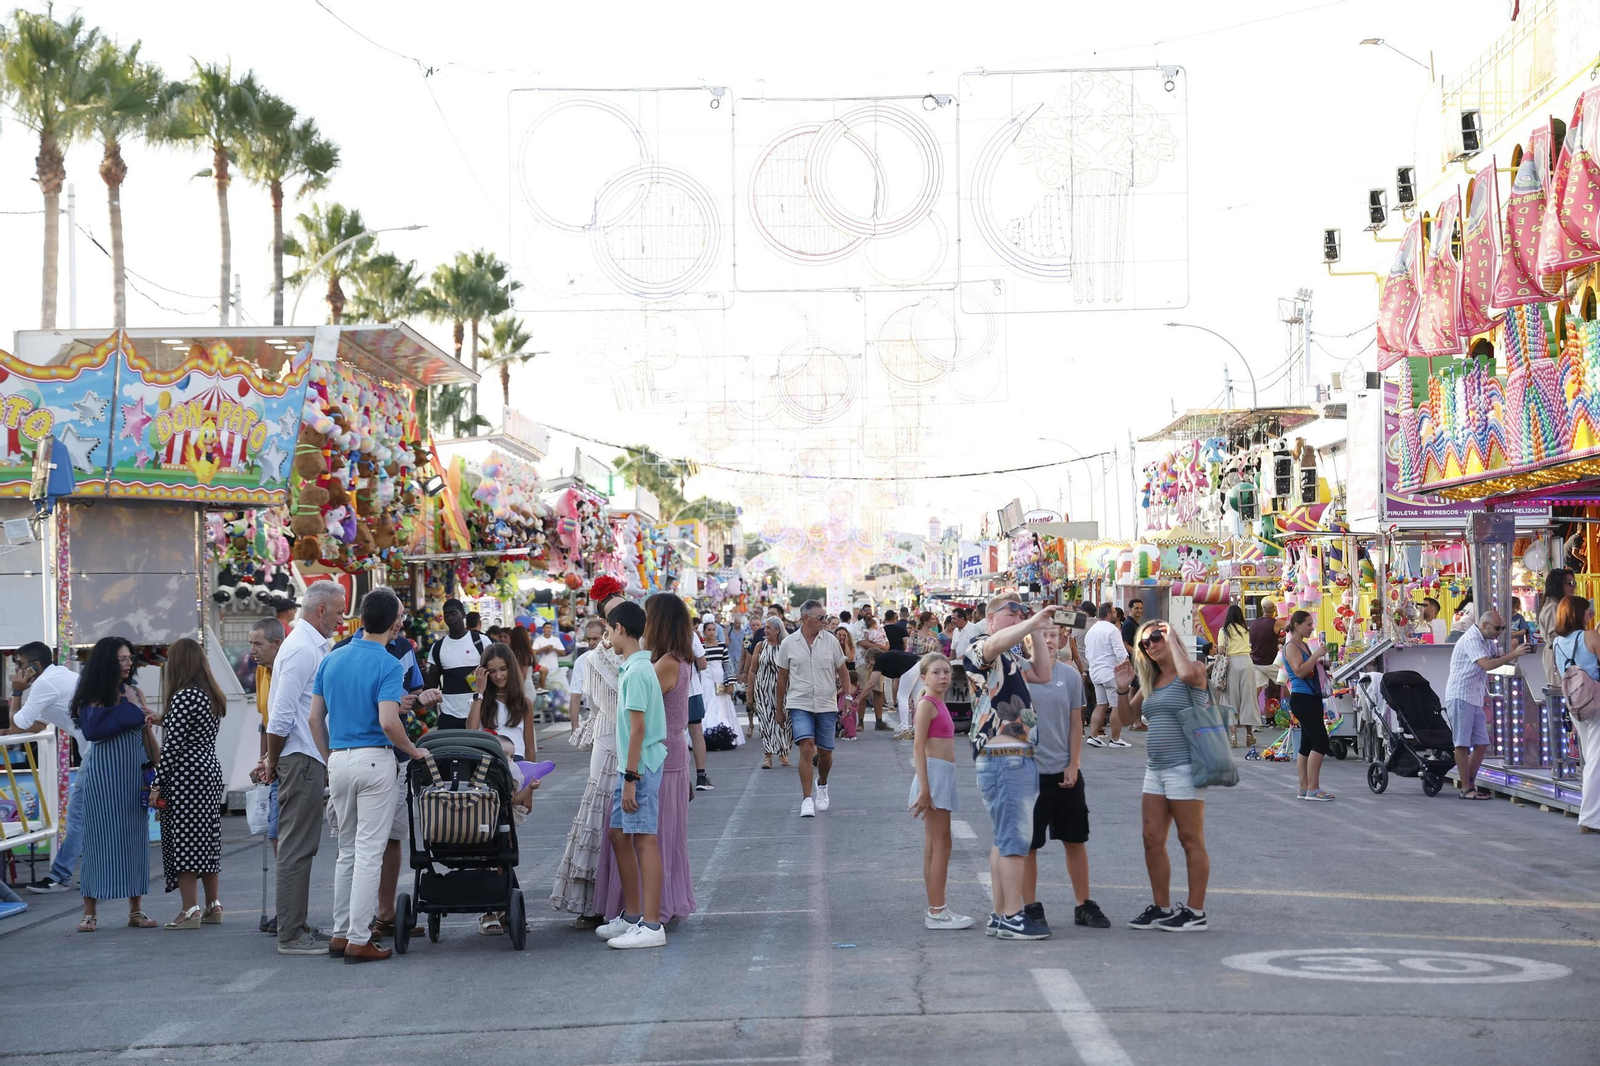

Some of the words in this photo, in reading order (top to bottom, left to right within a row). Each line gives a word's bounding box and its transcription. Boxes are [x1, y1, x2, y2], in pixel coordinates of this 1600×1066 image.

[0, 392, 54, 442] TO
[155, 399, 204, 445] DON
[217, 397, 268, 452] PATO
[1295, 956, 1496, 974] 30
